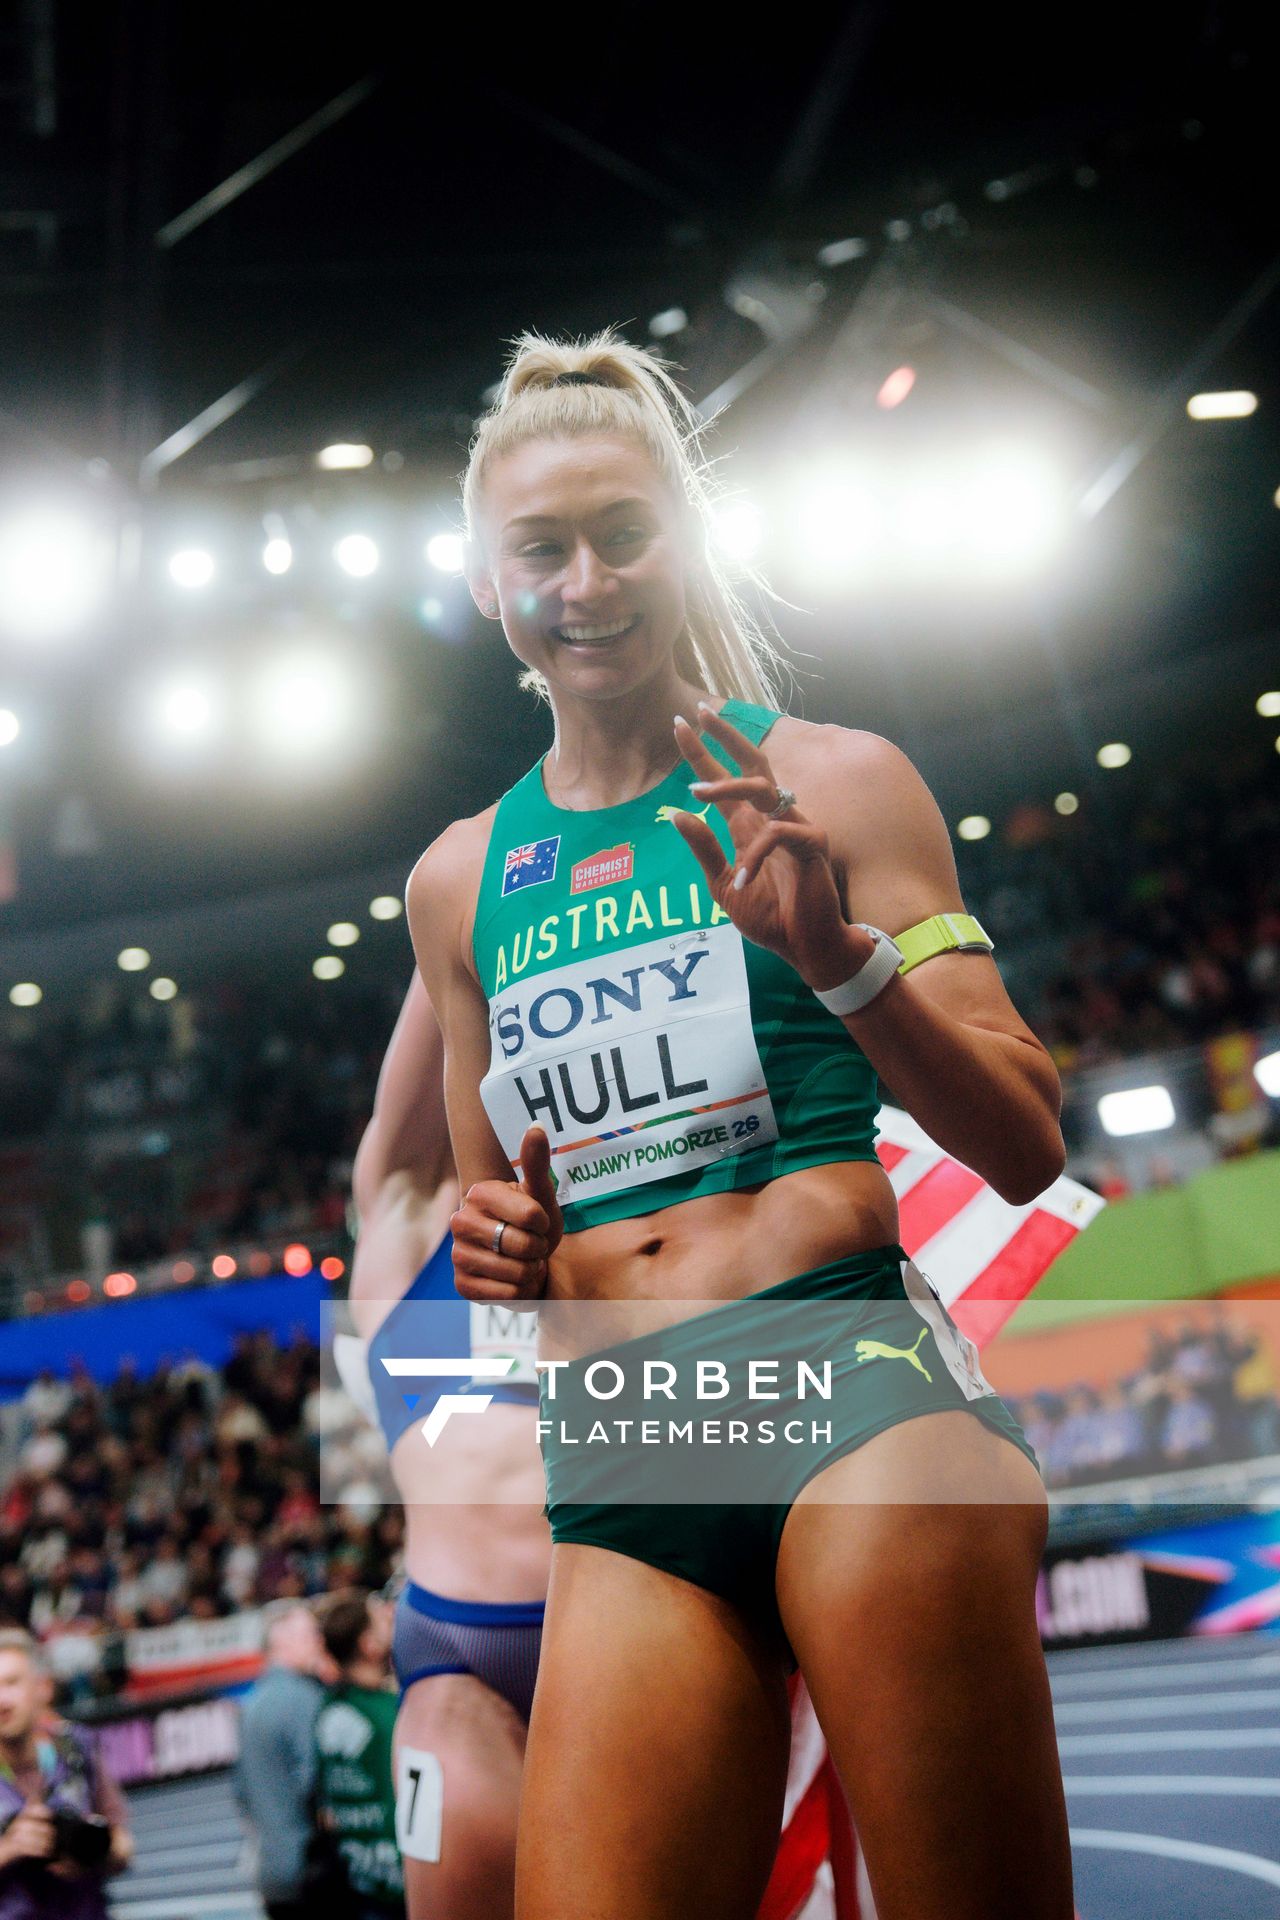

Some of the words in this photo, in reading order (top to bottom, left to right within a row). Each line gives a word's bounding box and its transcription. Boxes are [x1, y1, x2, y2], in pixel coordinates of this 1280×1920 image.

[575, 856, 630, 881] CHEMIST
[575, 869, 628, 889] WAREHOUSE
[497, 950, 709, 1060] SONY
[514, 1033, 709, 1133] HULL
[566, 1151, 631, 1185] KUJAWY
[635, 1125, 730, 1167] POMORZE
[731, 1114, 761, 1139] 26
[407, 1768, 421, 1836] 7
